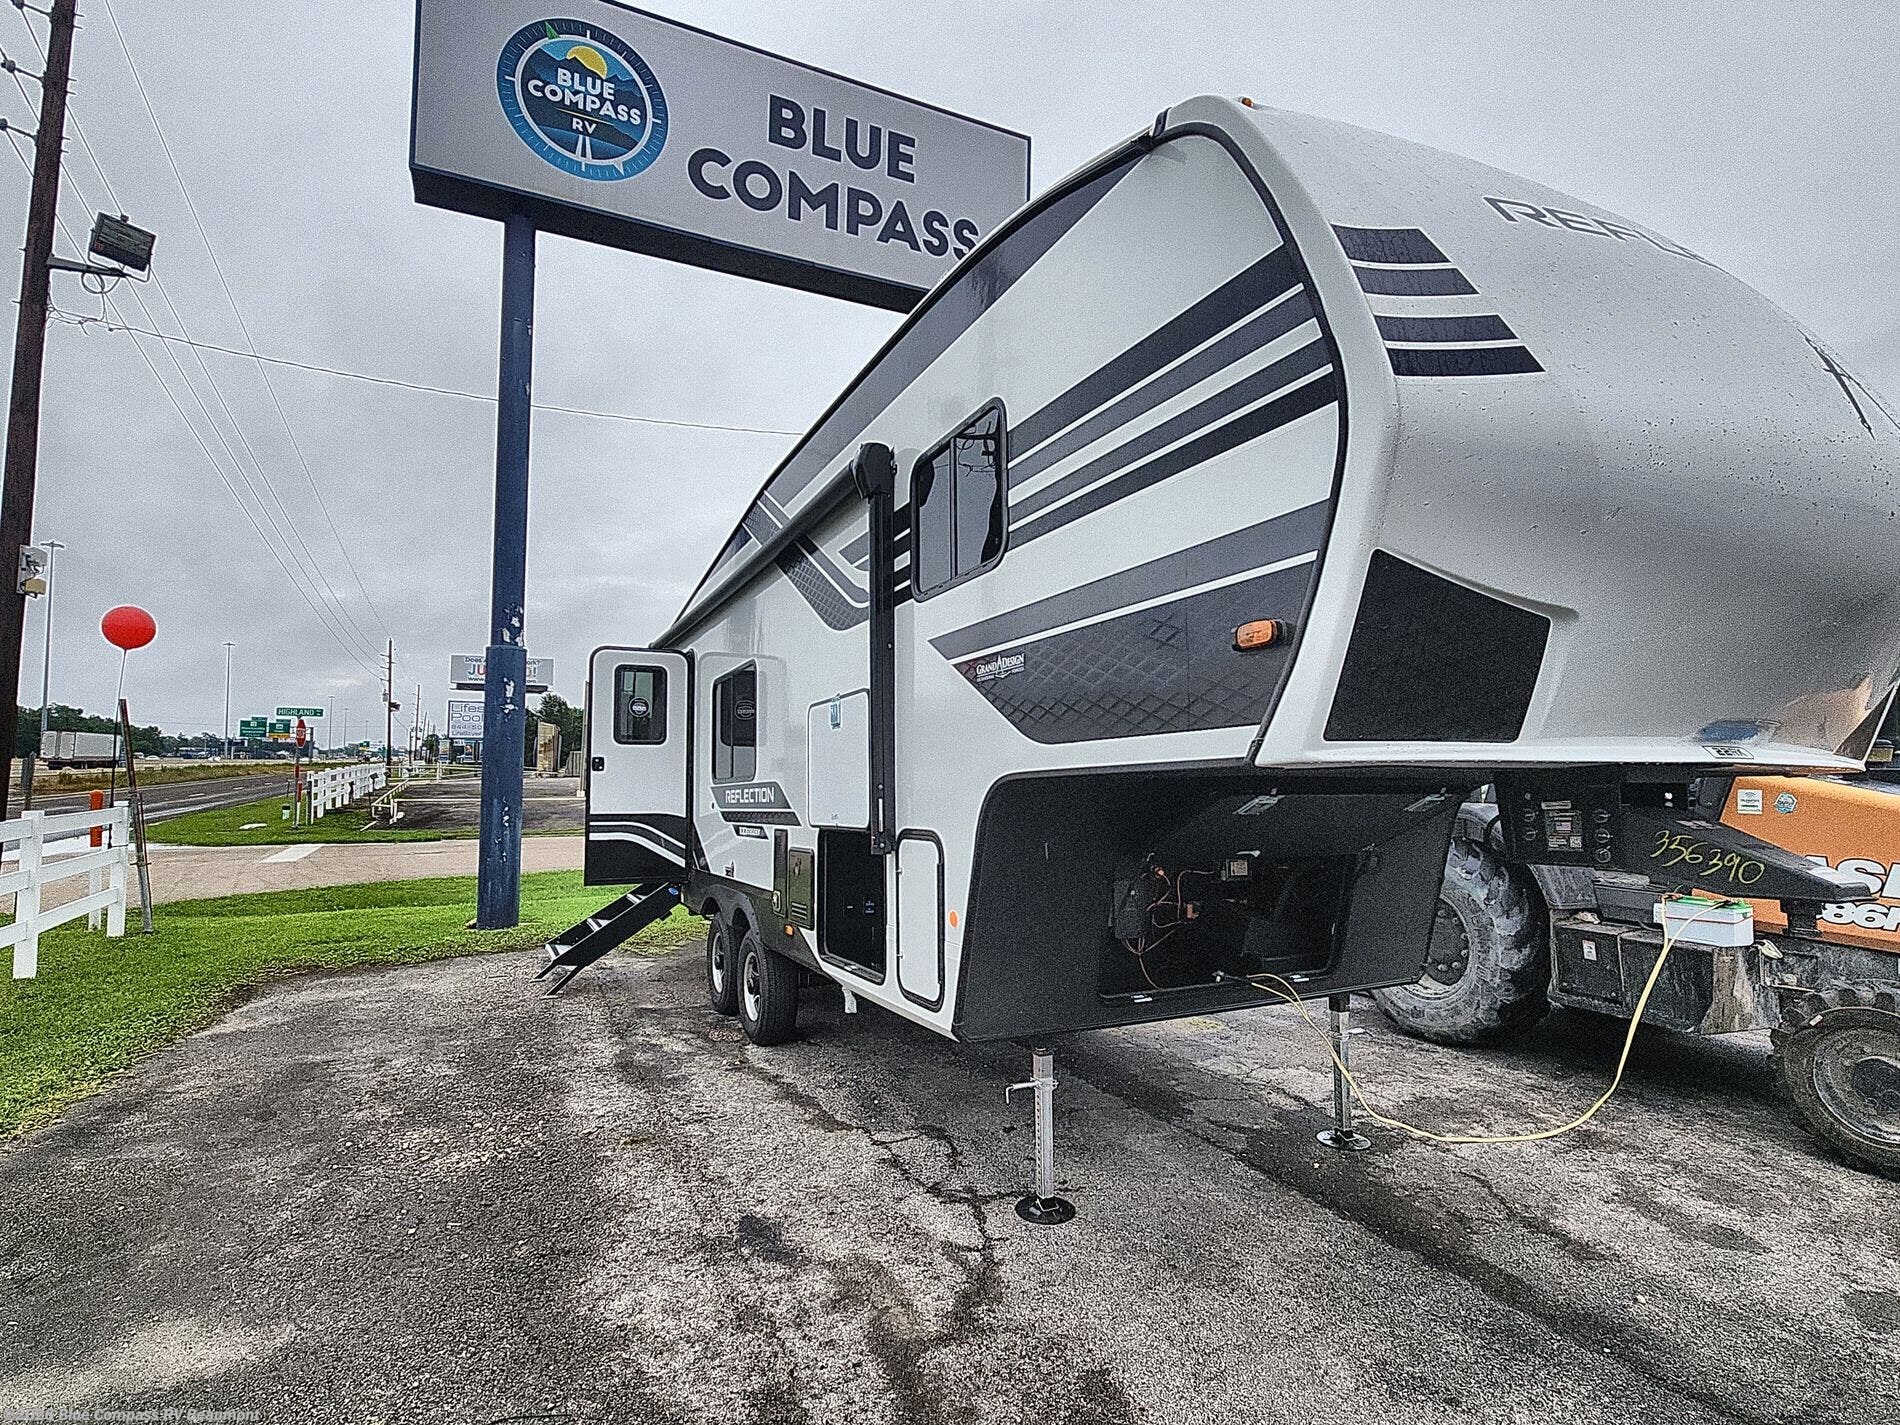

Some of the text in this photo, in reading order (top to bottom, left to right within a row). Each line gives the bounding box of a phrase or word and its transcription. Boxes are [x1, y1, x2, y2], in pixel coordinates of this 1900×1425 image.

[557, 67, 615, 100] BLUE
[527, 79, 641, 125] COMPASS
[572, 117, 597, 134] RV
[768, 94, 916, 184] BLUE
[687, 147, 979, 261] COMPASS
[976, 661, 997, 675] GRAND
[1002, 653, 1025, 668] DESIGN
[278, 708, 314, 716] HIGHLAND
[725, 786, 775, 804] REFLECTION
[1650, 830, 1765, 884] 356390
